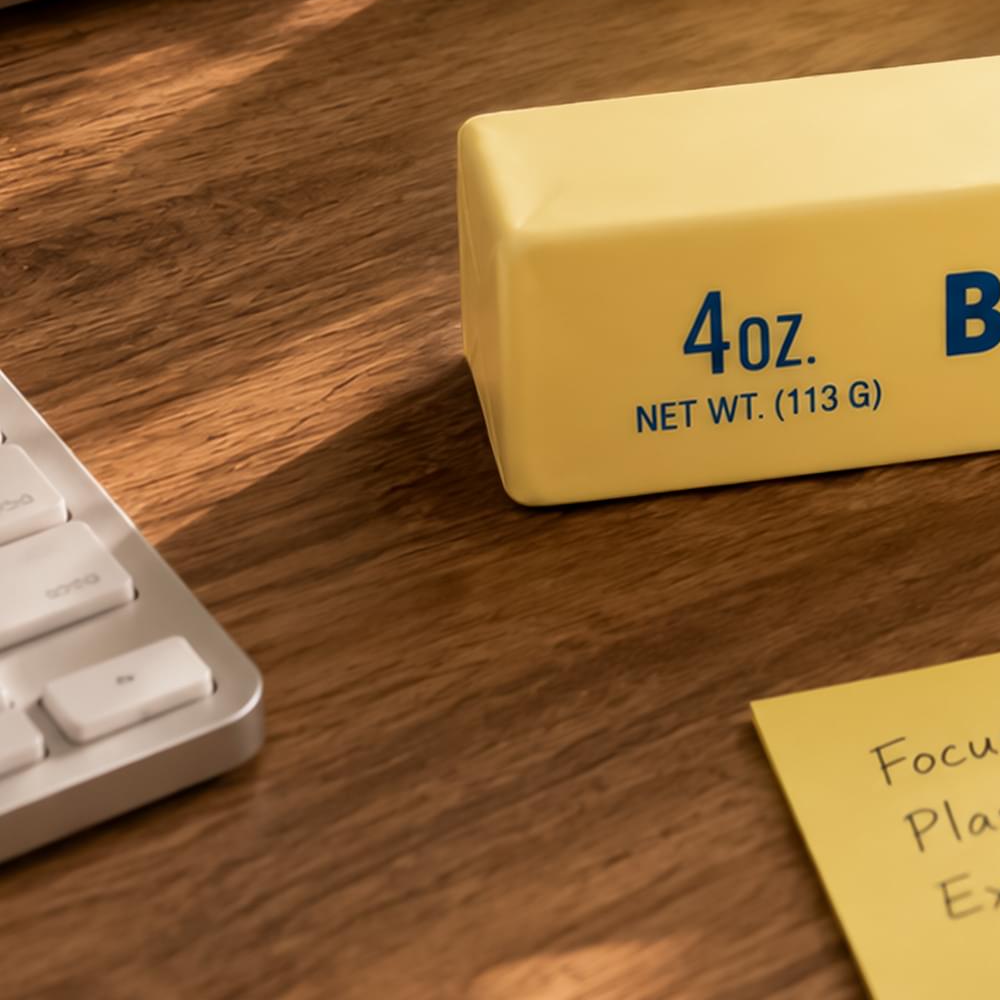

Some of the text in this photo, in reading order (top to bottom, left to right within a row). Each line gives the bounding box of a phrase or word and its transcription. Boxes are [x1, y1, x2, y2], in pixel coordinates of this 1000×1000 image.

[635, 378, 883, 434] NET WT. (113 G)
